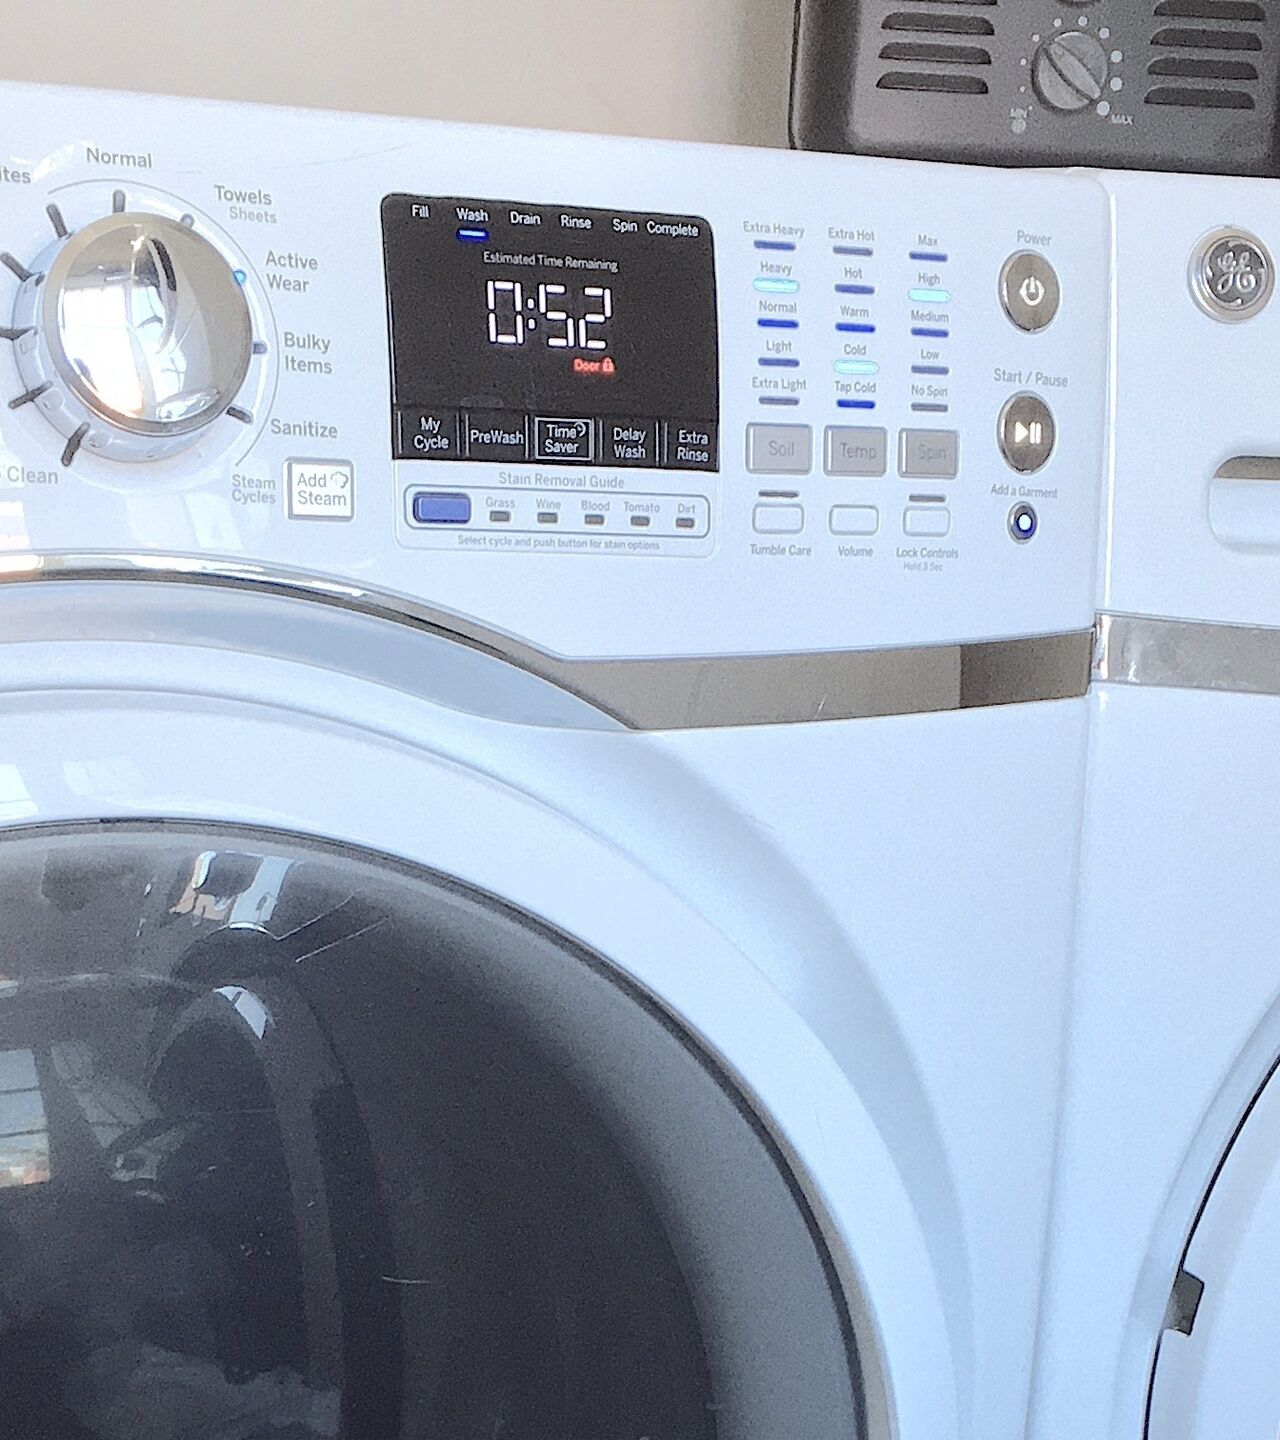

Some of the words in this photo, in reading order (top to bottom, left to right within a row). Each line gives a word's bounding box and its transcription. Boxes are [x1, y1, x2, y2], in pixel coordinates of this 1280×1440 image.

[86, 147, 152, 168] Normal
[213, 184, 272, 206] Towels
[229, 206, 277, 224] Sheets
[411, 204, 430, 218] Fill
[456, 207, 489, 223] Wash
[510, 210, 541, 226] Drain
[561, 215, 592, 230] Rinse
[612, 218, 638, 235] Spin
[646, 221, 699, 239] Complete
[743, 220, 771, 233] Extra
[773, 223, 805, 238] Heavy
[828, 227, 854, 240] Extra
[856, 229, 875, 242] Hot
[918, 234, 938, 247] Max
[1017, 229, 1052, 247] Power
[265, 249, 319, 270] Active
[483, 251, 535, 266] Estimated
[537, 254, 564, 268] Time
[565, 257, 618, 273] Remaining
[760, 261, 792, 276] Heavy
[844, 266, 862, 279] Hot
[1217, 251, 1257, 294] GE
[266, 272, 309, 293] Wear
[918, 272, 940, 286] High
[486, 279, 612, 350] 0:52
[758, 300, 797, 314] Normal
[840, 305, 869, 318] Warm
[910, 309, 949, 323] Medium
[284, 332, 331, 355] Bulky
[766, 339, 792, 353] Light
[843, 343, 867, 356] Cold
[920, 348, 939, 360] Low
[285, 355, 333, 374] Items
[573, 358, 600, 372] Door
[752, 376, 779, 389] Extra
[781, 377, 807, 391] Light
[994, 368, 1024, 385] Start
[1025, 371, 1033, 385] /
[1035, 372, 1069, 388] Pause
[834, 379, 852, 394] Tap
[854, 381, 876, 394] Cold
[911, 384, 926, 396] No
[928, 385, 948, 398] Spin
[271, 418, 338, 439] Sanitize
[420, 416, 441, 434] My
[546, 424, 577, 439] Time
[413, 434, 449, 451] Cycle
[470, 428, 524, 446] PreWash
[613, 427, 647, 445] Delay
[678, 429, 709, 446] Extra
[545, 439, 579, 454] Saver
[614, 445, 646, 460] Wash
[677, 446, 709, 463] Rinse
[768, 440, 796, 457] Soil
[839, 442, 878, 461] Temp
[917, 444, 947, 463] Spin
[7, 466, 59, 485] Clean
[232, 474, 276, 491] Steam
[297, 473, 327, 488] Add
[498, 471, 531, 486] Stain
[535, 472, 587, 487] Removal
[589, 474, 625, 488] Guide
[232, 489, 276, 505] Cycles
[297, 490, 347, 507] Steam
[991, 483, 1009, 497] Add
[1010, 486, 1017, 497] a
[1018, 485, 1058, 500] Garment
[485, 496, 515, 509] Grass
[535, 498, 562, 510] Wine
[581, 499, 610, 512] Blood
[624, 501, 661, 513] Tomato
[677, 503, 696, 514] Dirt
[458, 534, 487, 546] Select
[488, 536, 512, 548] cycle
[514, 537, 532, 548] and
[533, 537, 556, 549] push
[557, 538, 588, 549] button
[589, 538, 602, 549] for
[627, 540, 661, 551] options
[750, 543, 786, 556] Tumble
[788, 544, 812, 557] Care
[837, 545, 874, 558] Volume
[896, 547, 918, 559] Lock
[919, 548, 959, 560] Controls
